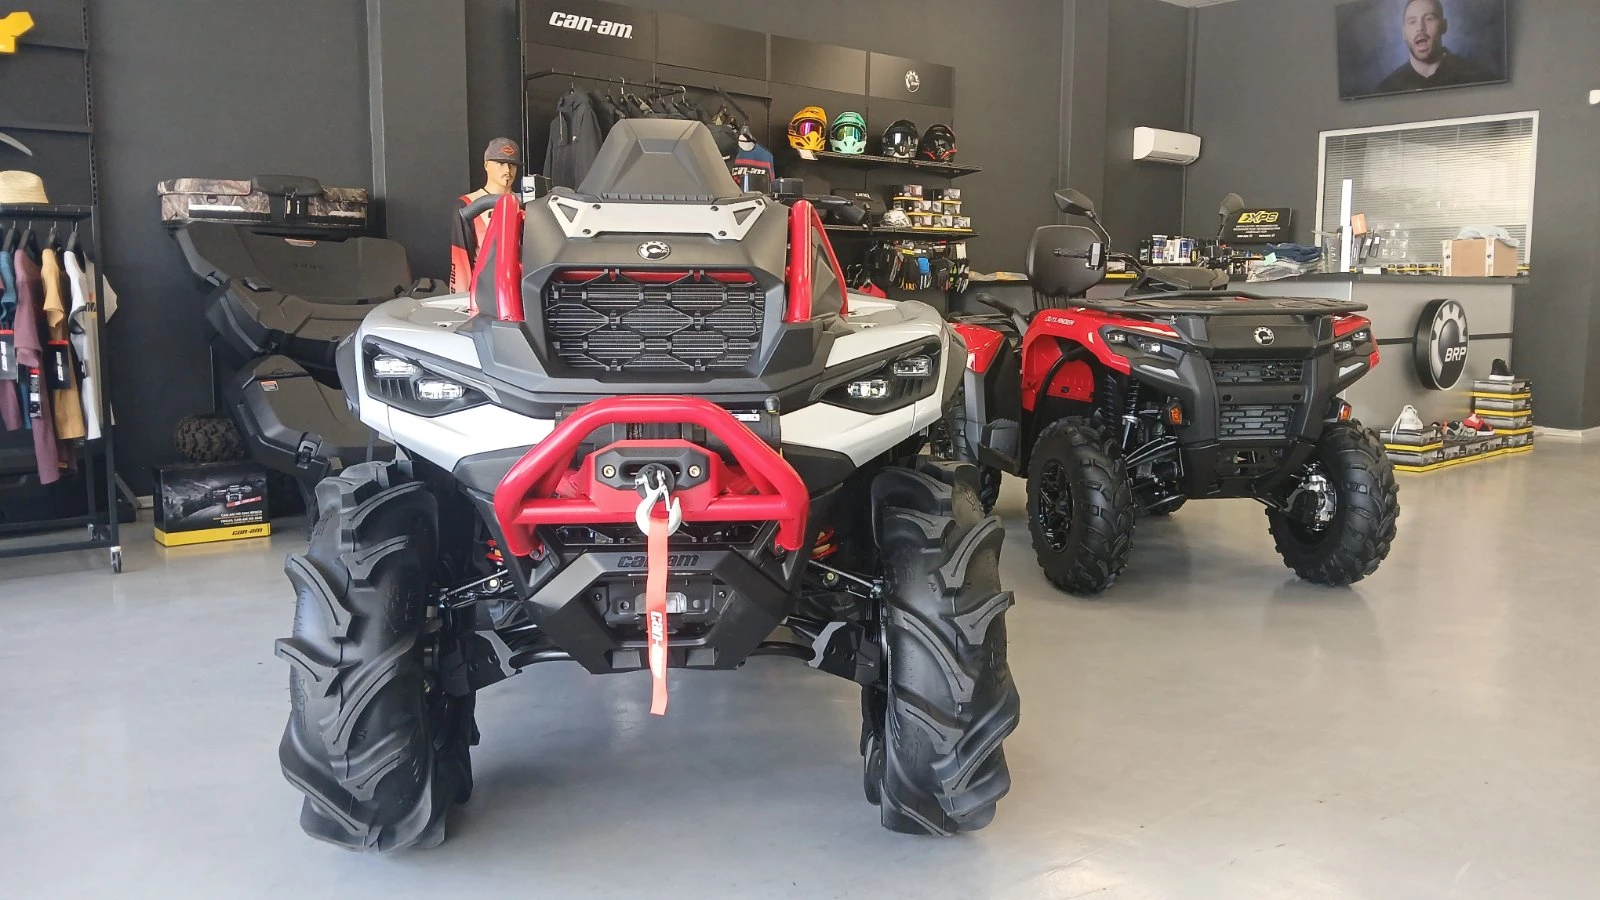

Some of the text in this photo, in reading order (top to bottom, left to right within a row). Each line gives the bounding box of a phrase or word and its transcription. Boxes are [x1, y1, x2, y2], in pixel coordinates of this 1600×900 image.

[549, 11, 632, 39] can-am
[1245, 210, 1279, 224] XPS
[1445, 346, 1467, 362] BRP
[232, 528, 263, 536] can-am
[617, 553, 699, 568] caam
